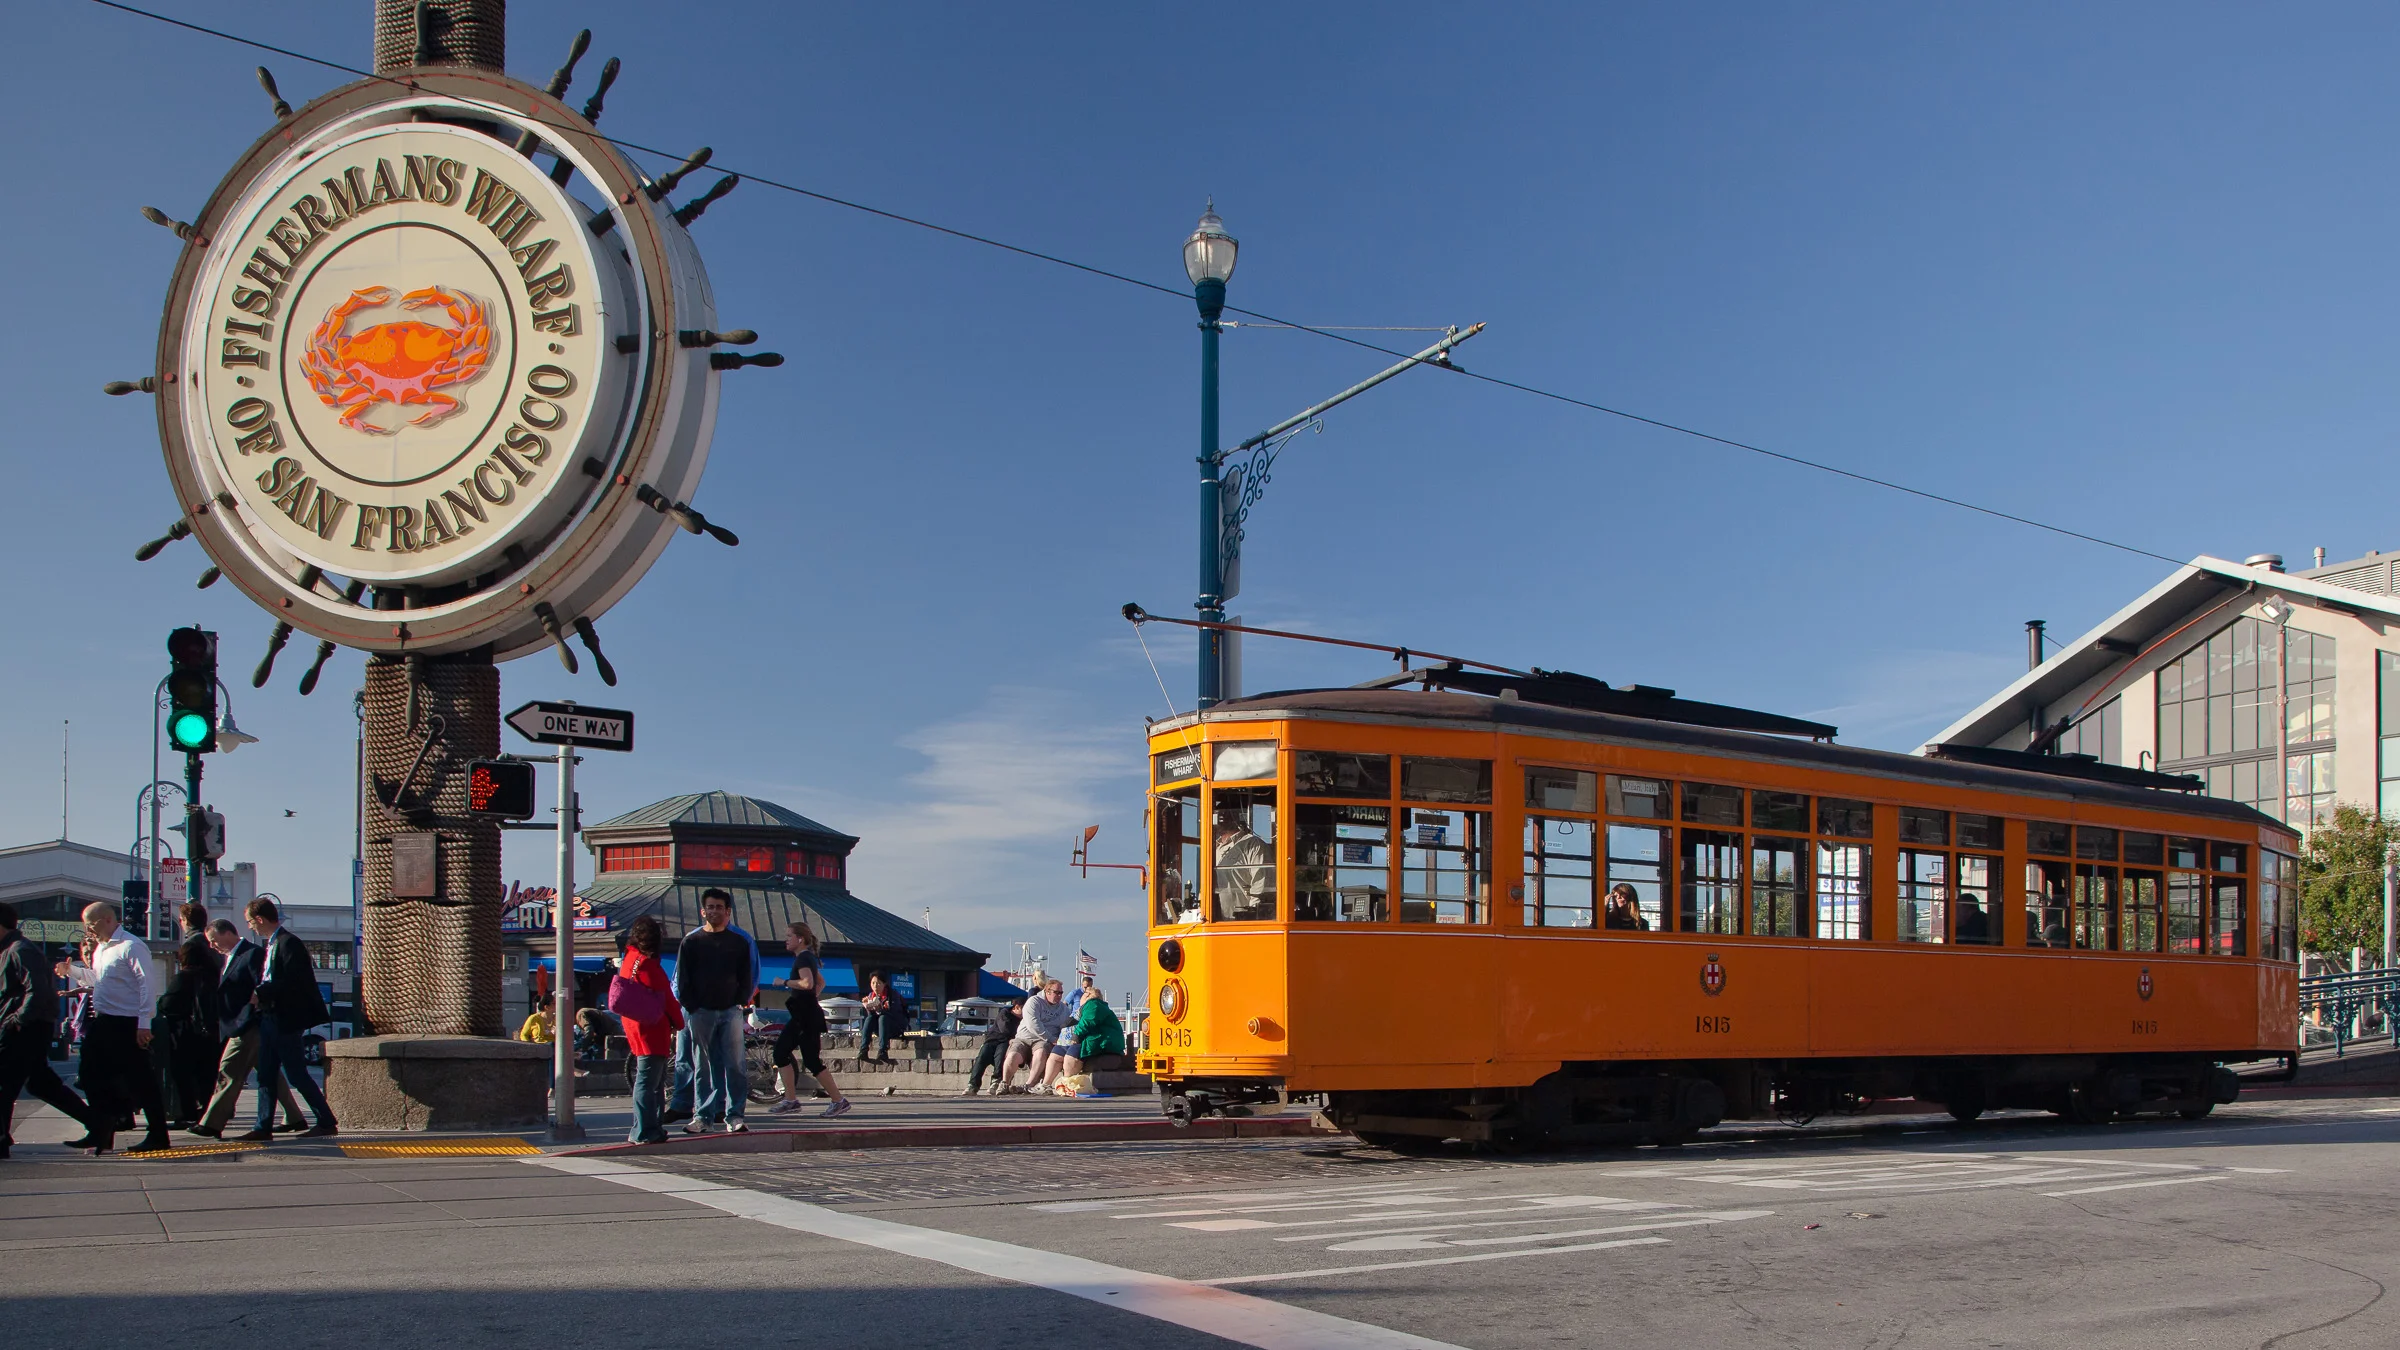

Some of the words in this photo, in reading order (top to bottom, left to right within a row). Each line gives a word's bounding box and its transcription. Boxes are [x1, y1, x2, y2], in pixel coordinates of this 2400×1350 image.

[221, 154, 466, 371] FISHERMANS
[464, 167, 584, 338] WHARF
[226, 397, 287, 457] OF
[351, 364, 577, 553] FRANCISCO
[255, 455, 352, 540] SAN
[544, 716, 579, 733] ONE
[585, 719, 620, 737] WAY
[1172, 764, 1194, 777] WHARF
[163, 865, 176, 873] NO
[573, 919, 603, 927] RILL
[1696, 1016, 1731, 1033] 1815
[2132, 1020, 2158, 1034] 1815
[1160, 1027, 1192, 1047] 1815
